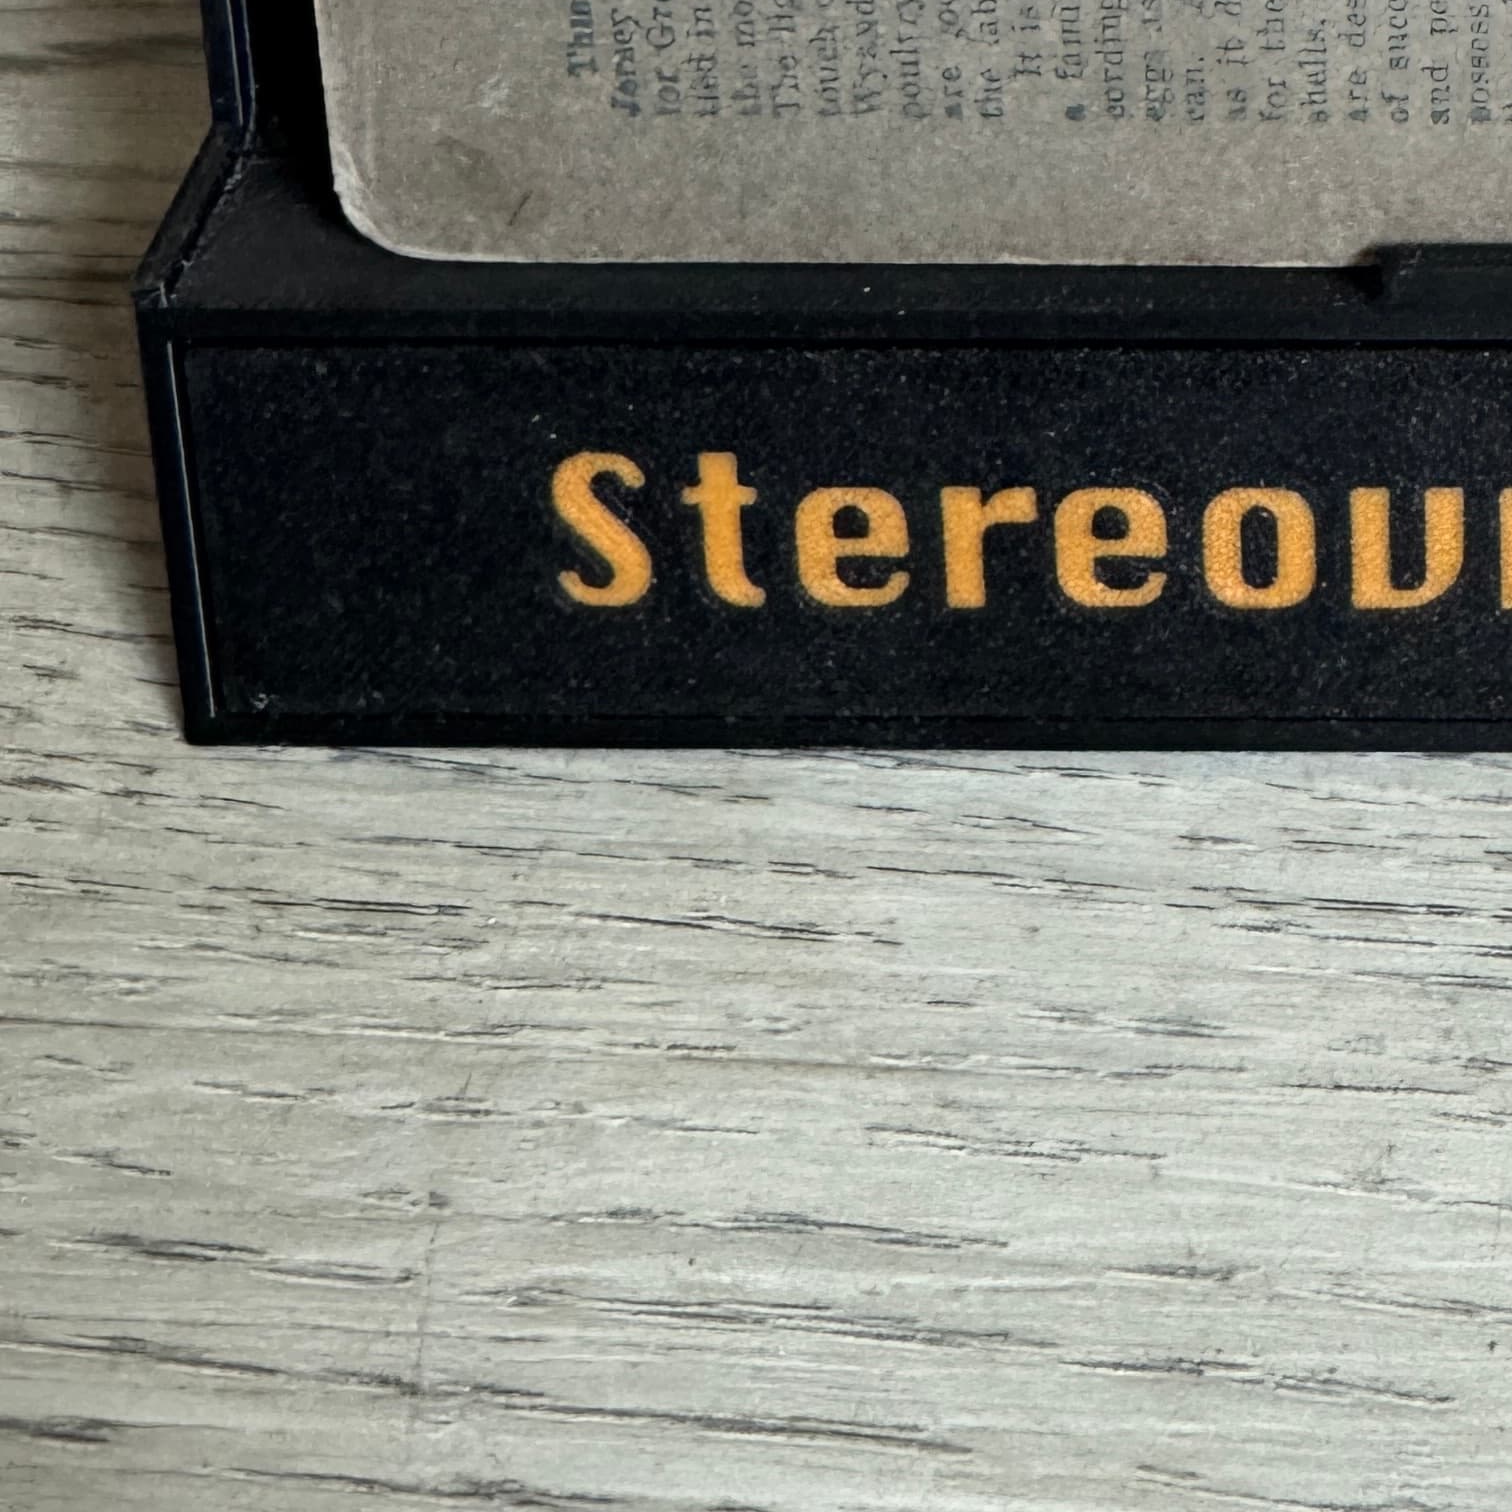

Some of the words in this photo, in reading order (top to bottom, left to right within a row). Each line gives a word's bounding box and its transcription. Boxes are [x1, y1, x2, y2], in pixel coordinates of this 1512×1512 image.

[1014, 7, 1036, 31] is
[1258, 0, 1284, 50] the
[1187, 57, 1206, 123] can.
